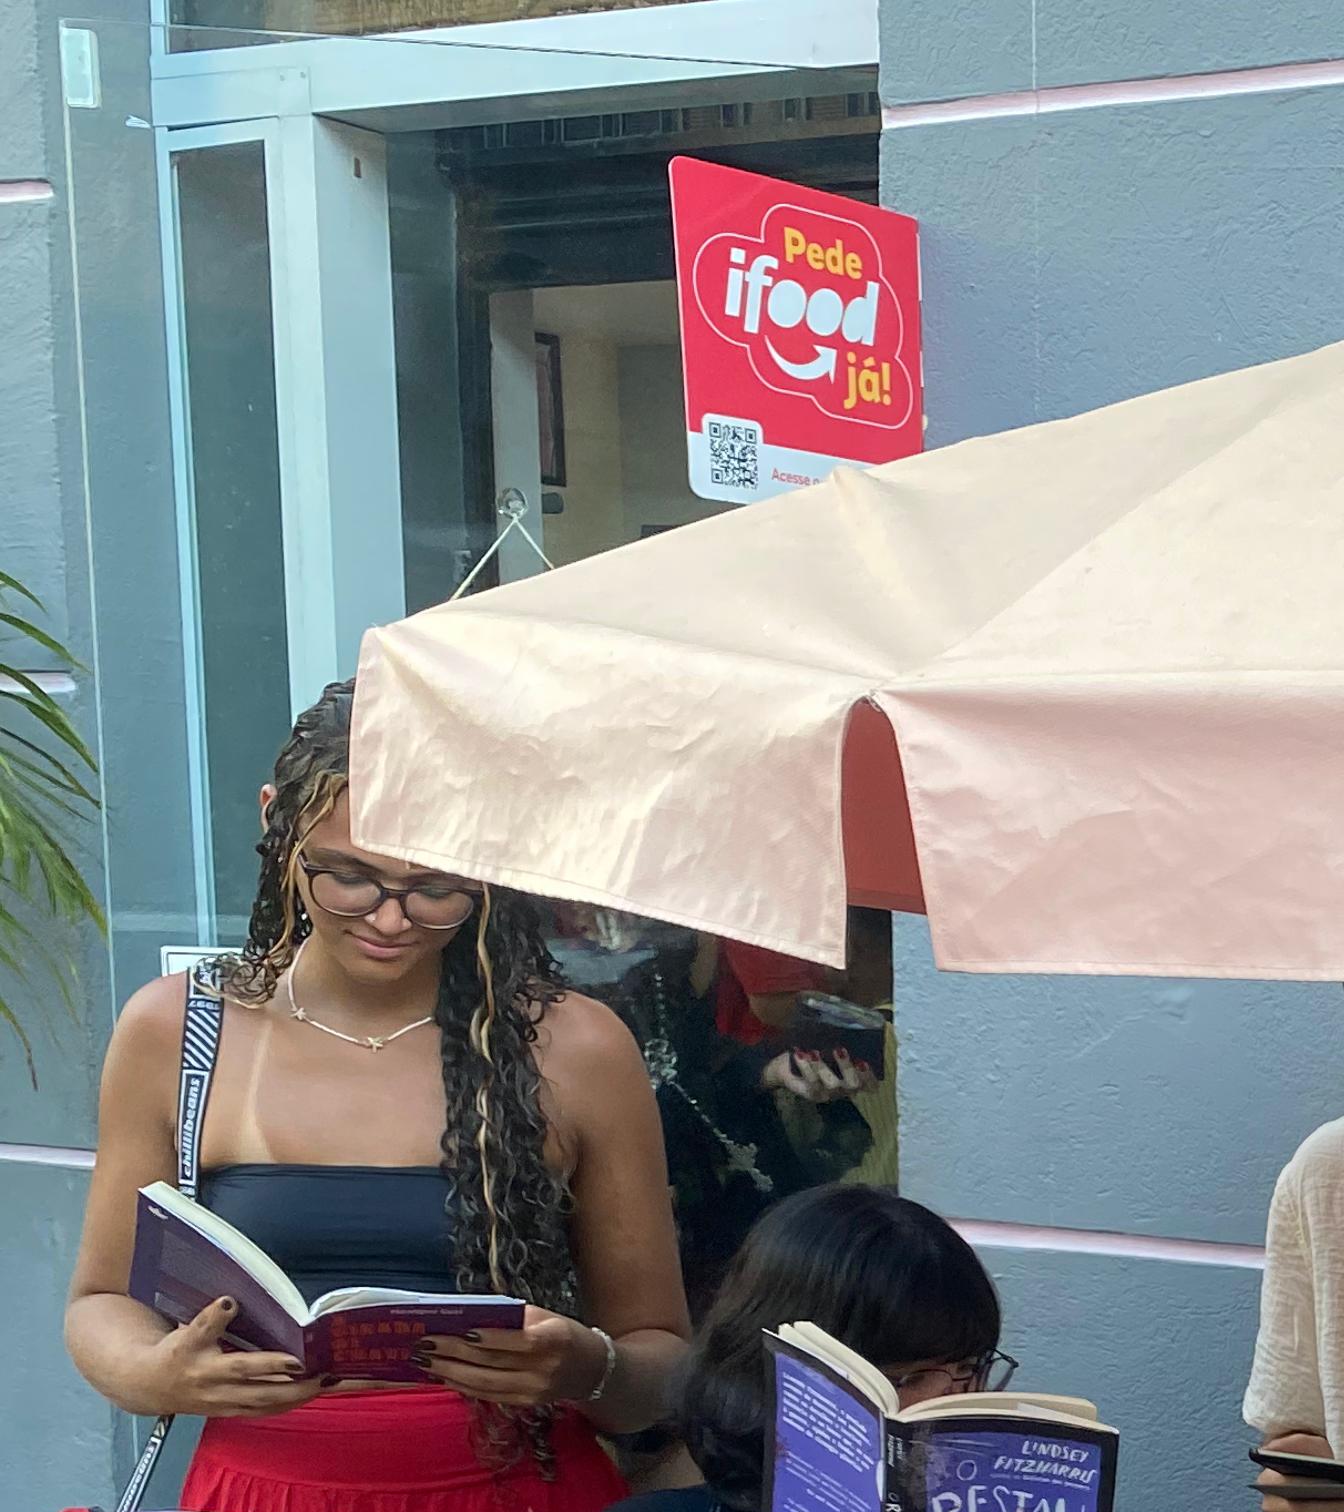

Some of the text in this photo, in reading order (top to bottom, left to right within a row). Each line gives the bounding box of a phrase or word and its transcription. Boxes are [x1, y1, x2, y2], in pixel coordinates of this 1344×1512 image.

[783, 227, 863, 280] Pede
[724, 247, 880, 347] ifood
[843, 350, 892, 411] já!
[771, 466, 811, 487] Acesse
[993, 1455, 1098, 1484] FITZHARRIS
[1021, 1440, 1090, 1463] LINDSEY
